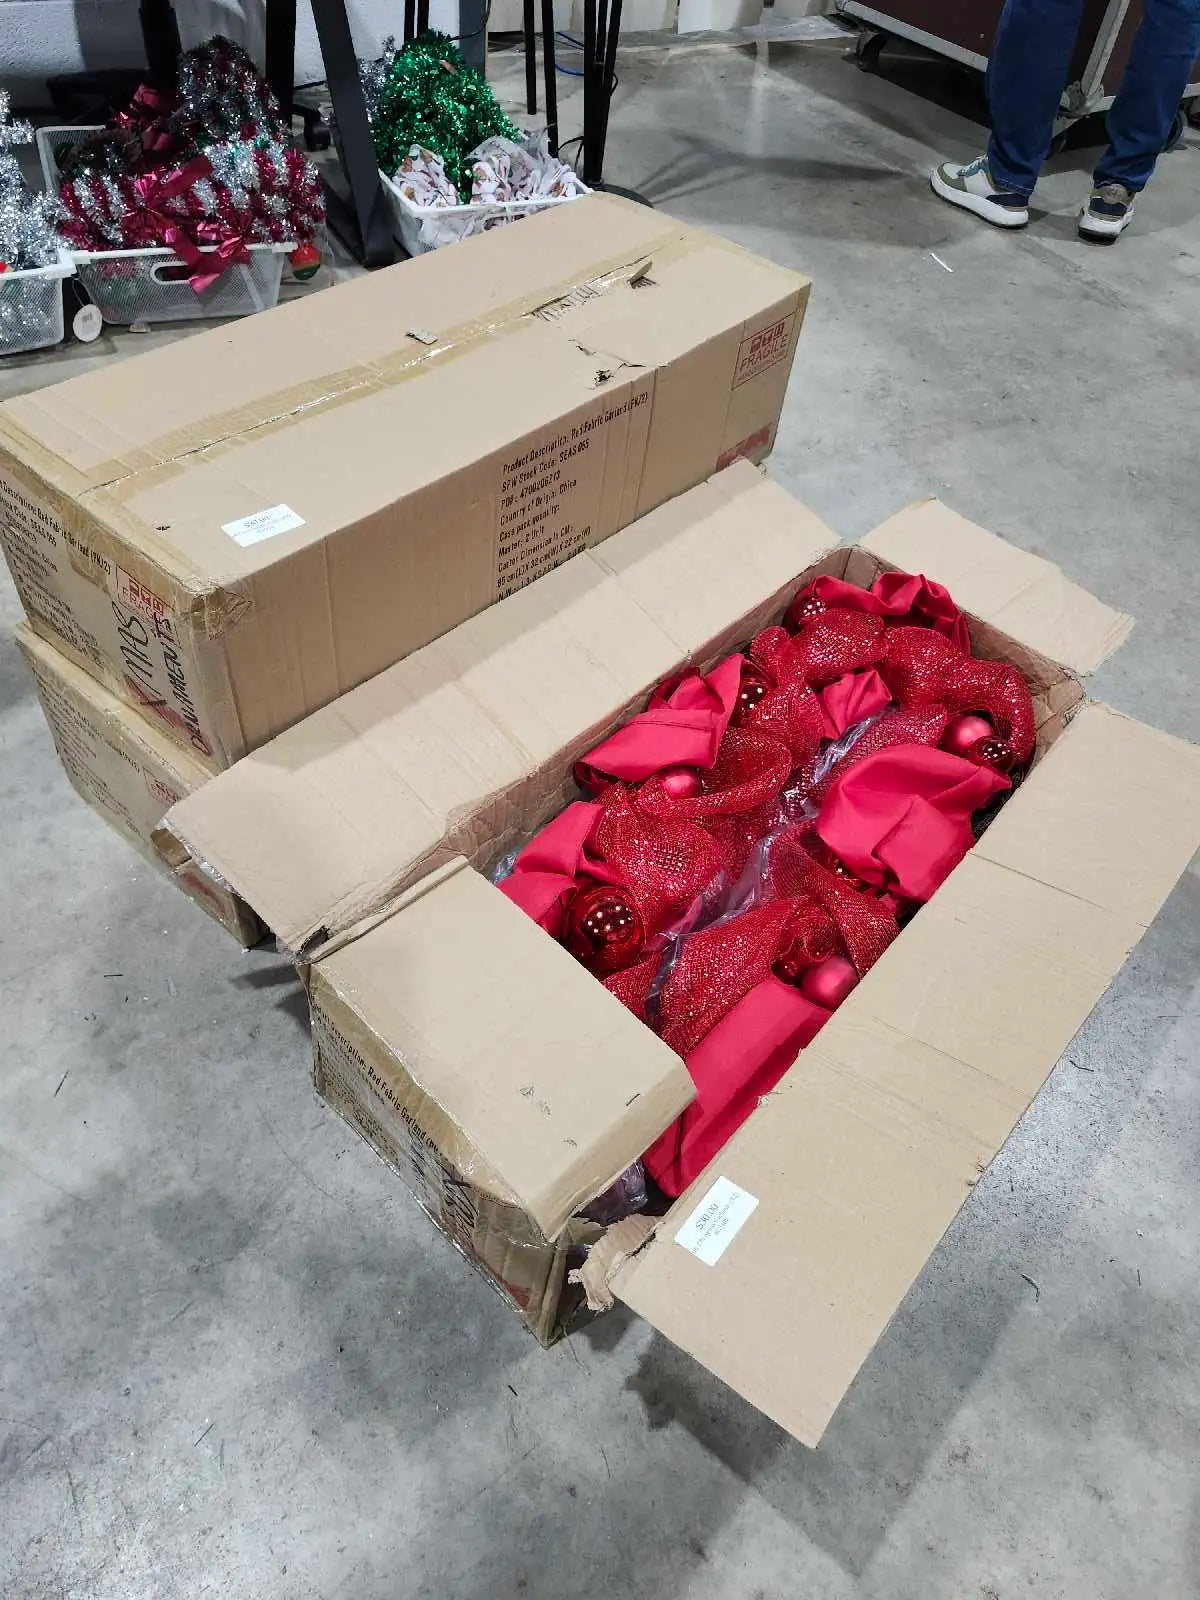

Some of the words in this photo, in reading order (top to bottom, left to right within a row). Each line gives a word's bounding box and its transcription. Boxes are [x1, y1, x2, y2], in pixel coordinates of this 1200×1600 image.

[740, 334, 788, 371] FRAGILE
[503, 455, 528, 474] Product
[381, 1083, 401, 1111] Fabric
[401, 1106, 427, 1140] Garland
